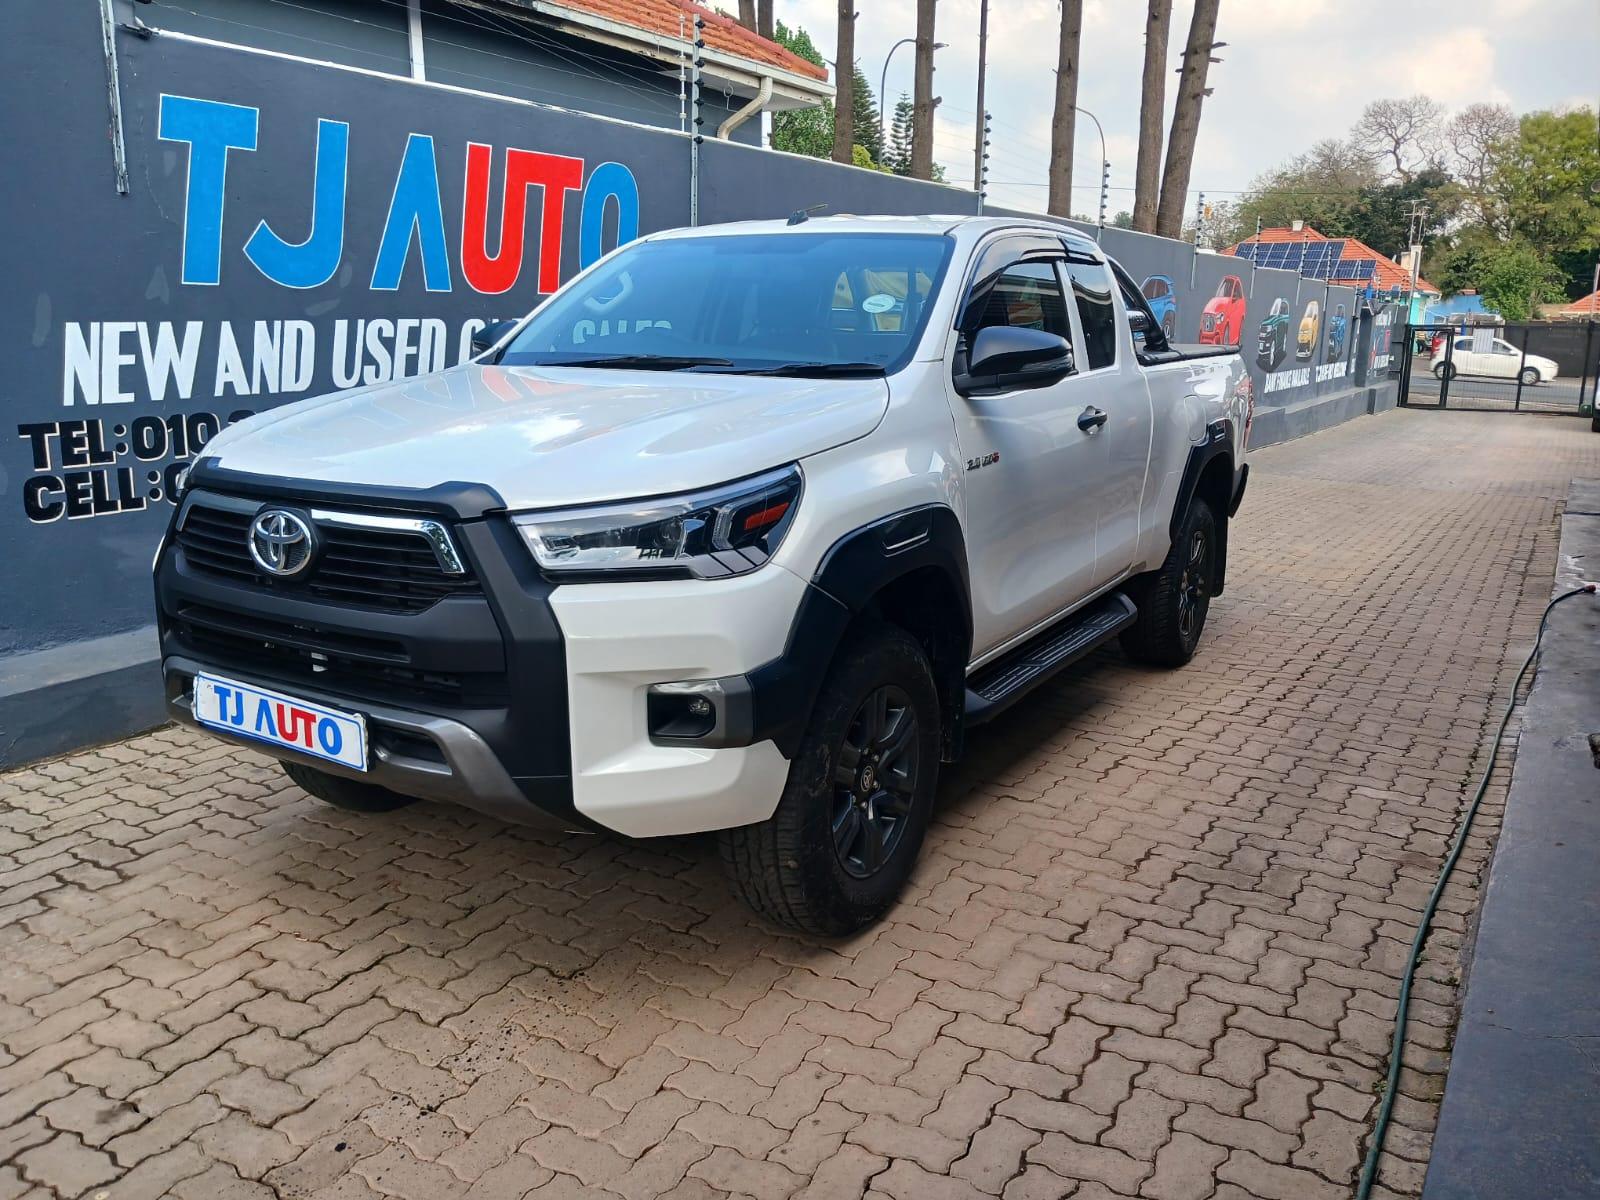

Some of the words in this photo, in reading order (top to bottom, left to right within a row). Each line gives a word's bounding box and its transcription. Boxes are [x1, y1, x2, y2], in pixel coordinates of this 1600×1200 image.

[157, 92, 349, 289] TJ
[369, 132, 640, 294] AUTO
[62, 320, 203, 406] NEW
[214, 319, 316, 396] AND
[332, 318, 446, 389] USED
[213, 684, 245, 727] TJ
[255, 698, 343, 755] AUTO
